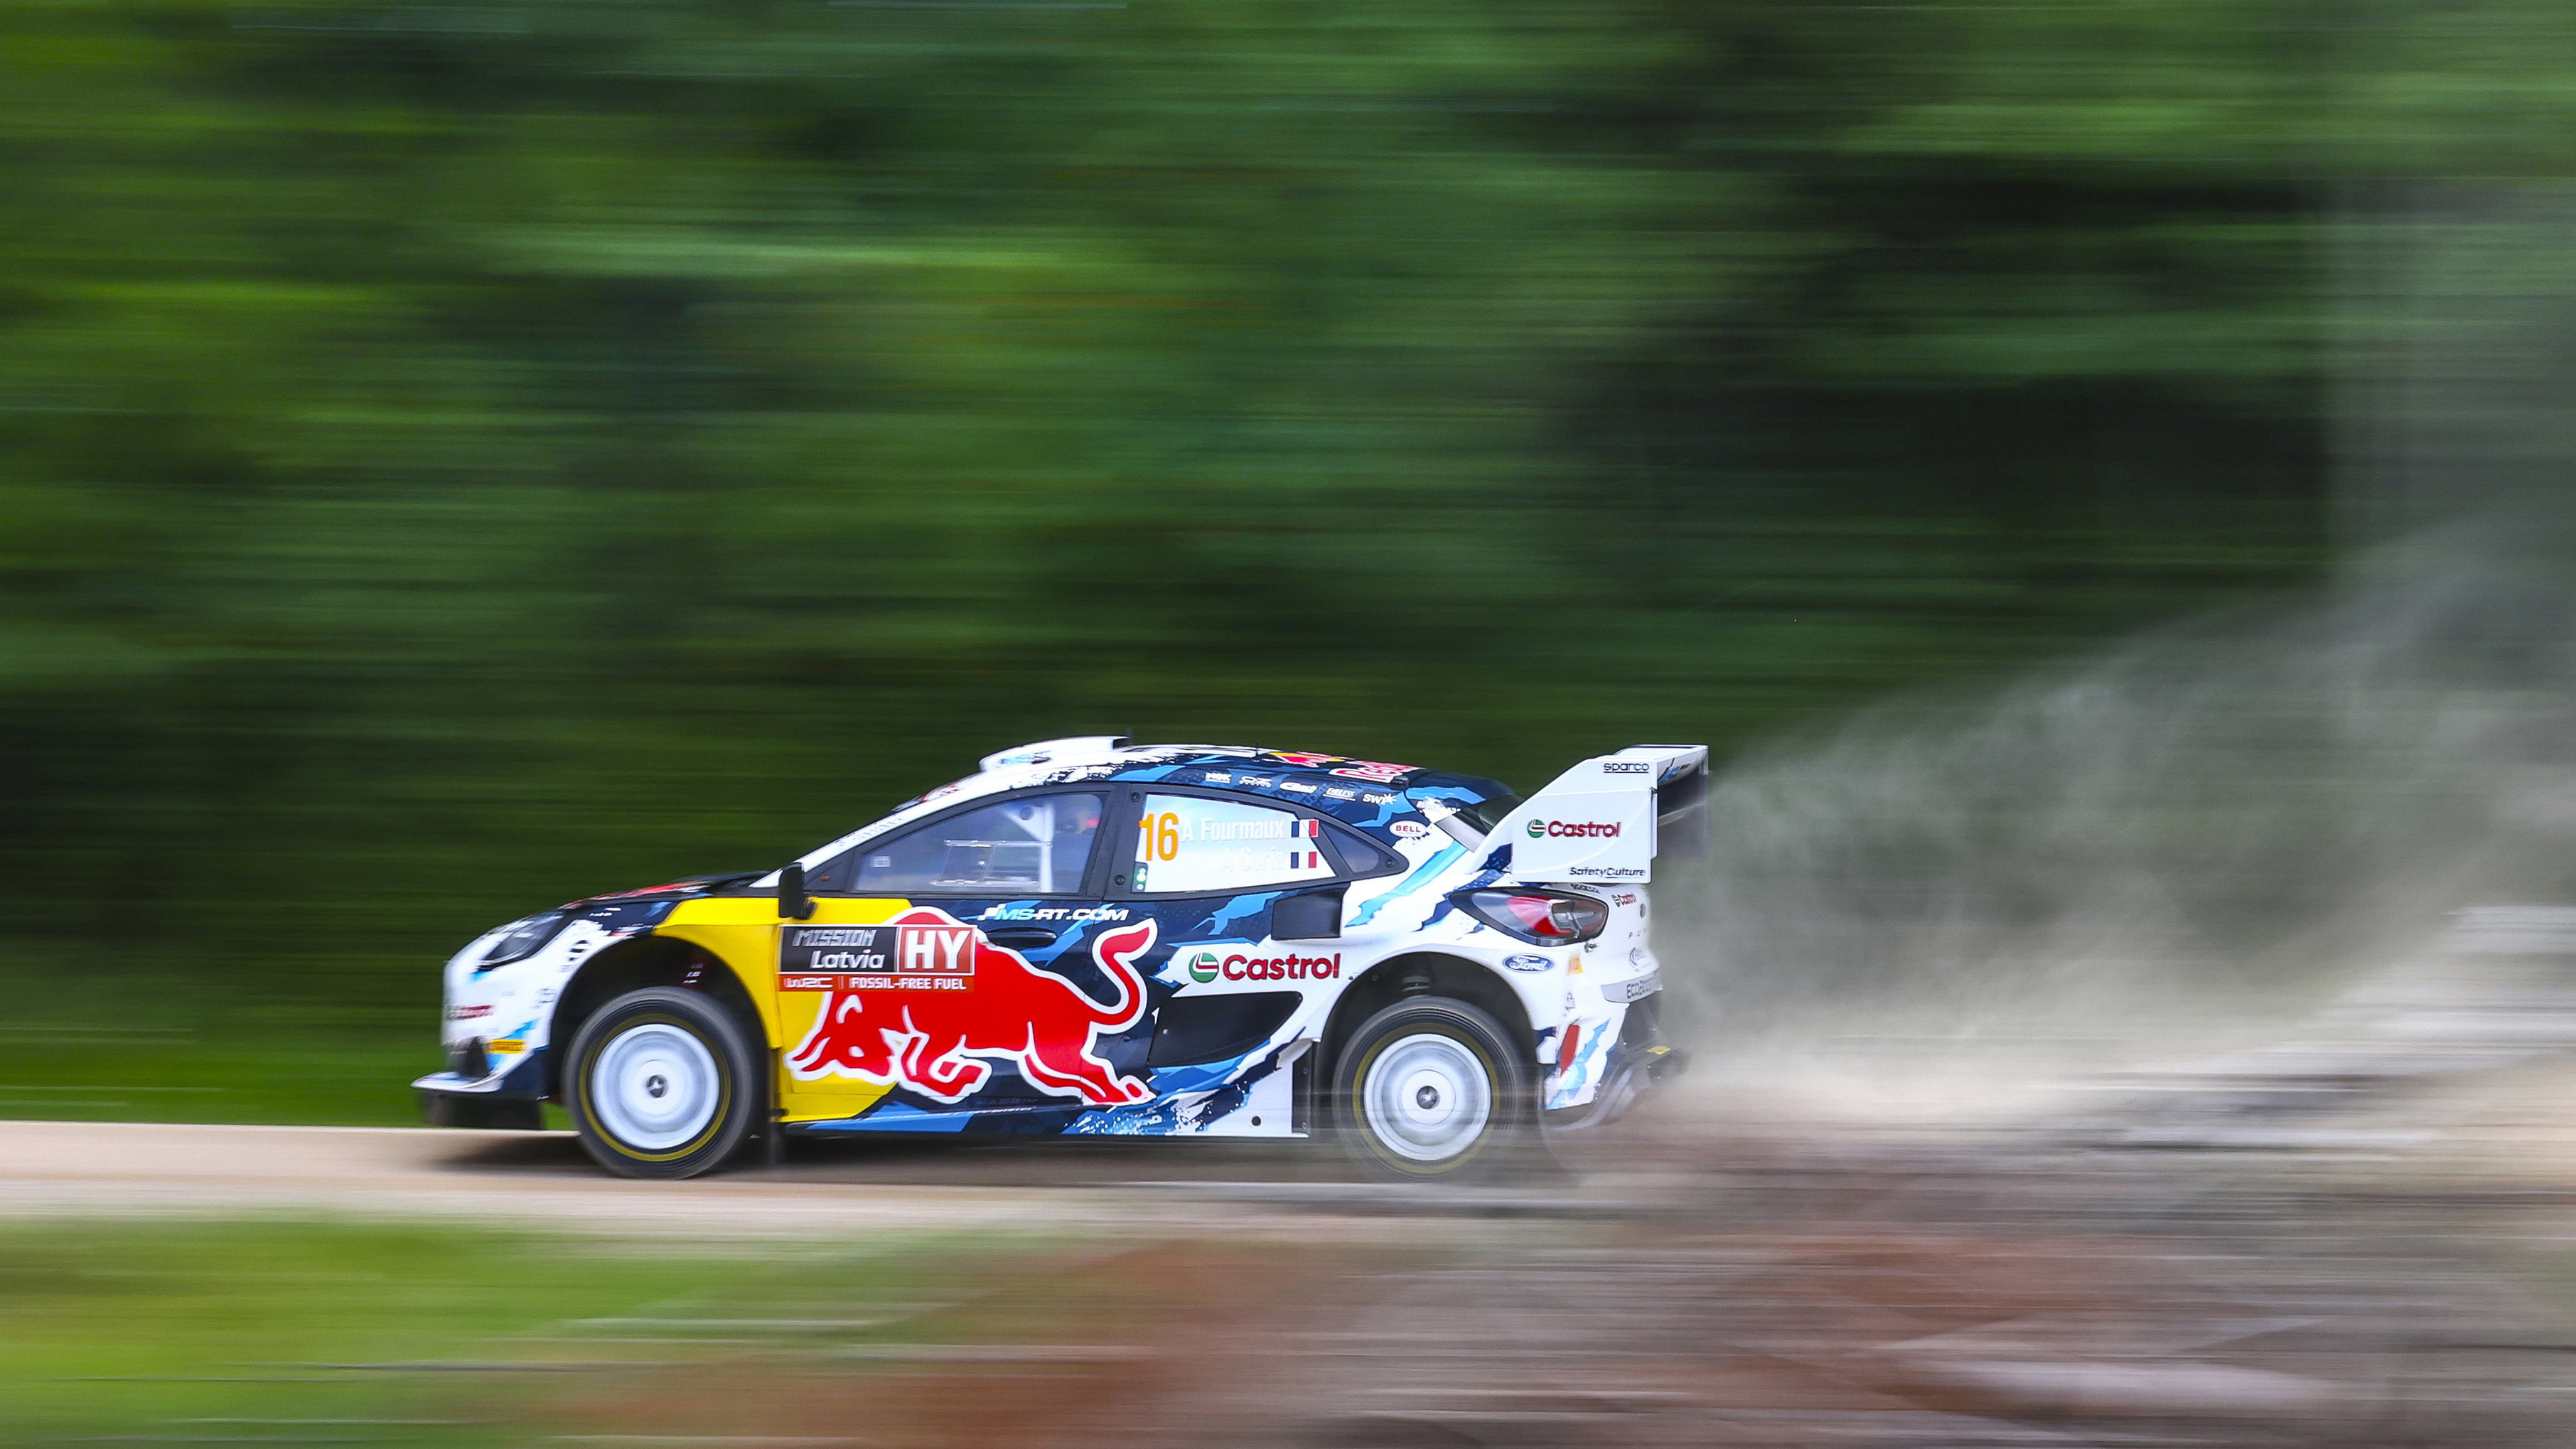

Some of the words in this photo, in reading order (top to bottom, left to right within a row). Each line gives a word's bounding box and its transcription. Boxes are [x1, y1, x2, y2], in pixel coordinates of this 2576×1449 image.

[1604, 763, 1649, 774] sparco
[1139, 812, 1179, 861] 16
[1181, 820, 1195, 842] A
[1201, 818, 1284, 841] Fourmaux
[1548, 820, 1621, 838] Castrol
[1569, 867, 1646, 879] SafetyCulture
[792, 929, 877, 946] MISSION
[810, 949, 886, 968] Latvia
[905, 930, 970, 969] HY
[1223, 953, 1341, 980] Castrol
[849, 977, 932, 989] FOSSIL-FREE
[935, 978, 967, 990] FUEL
